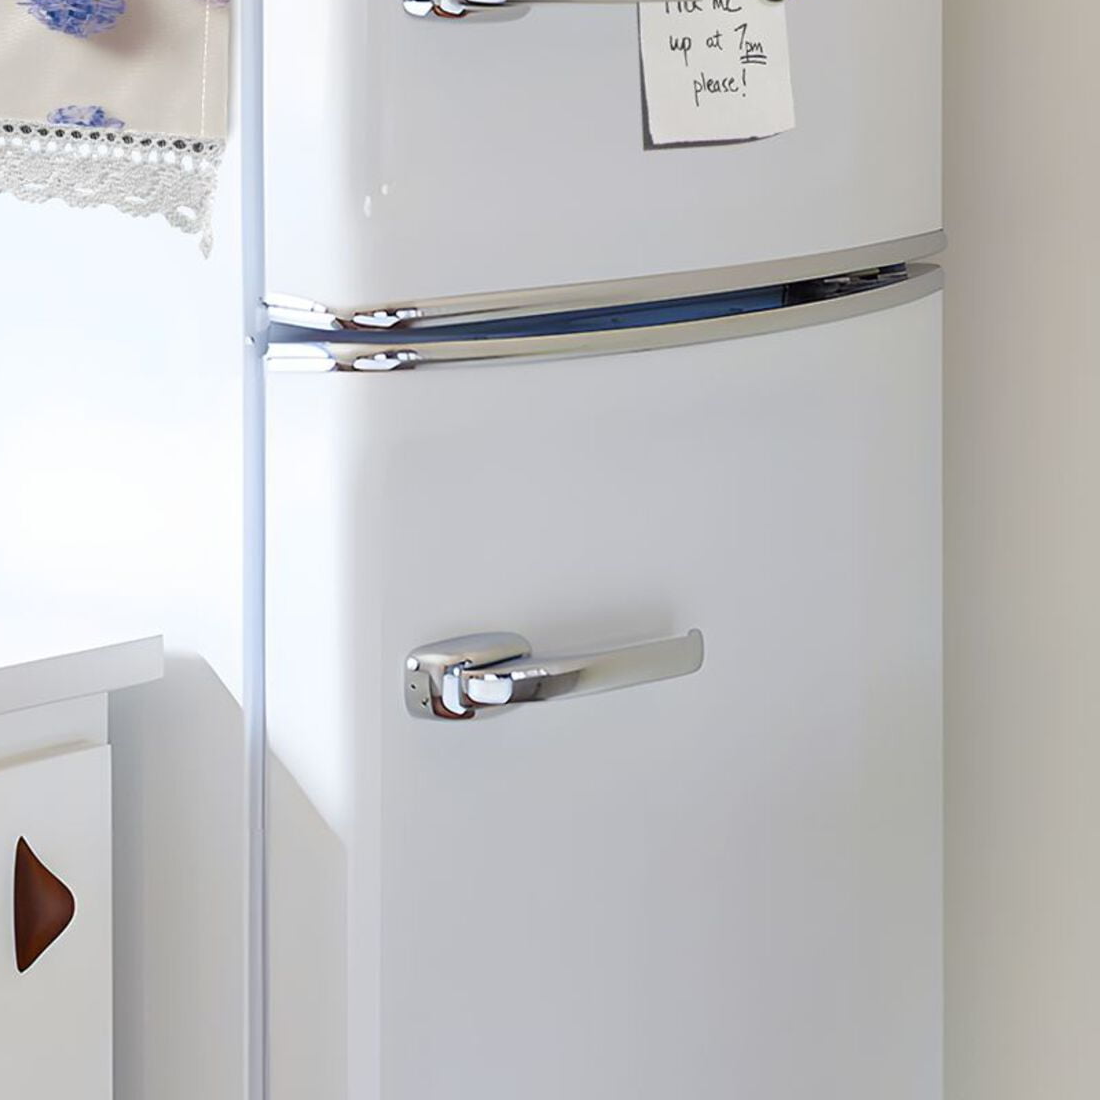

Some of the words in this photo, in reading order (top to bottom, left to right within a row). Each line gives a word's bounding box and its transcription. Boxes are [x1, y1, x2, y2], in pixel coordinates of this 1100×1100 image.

[669, 35, 692, 67] up
[706, 30, 723, 51] at
[693, 68, 747, 107] please!
